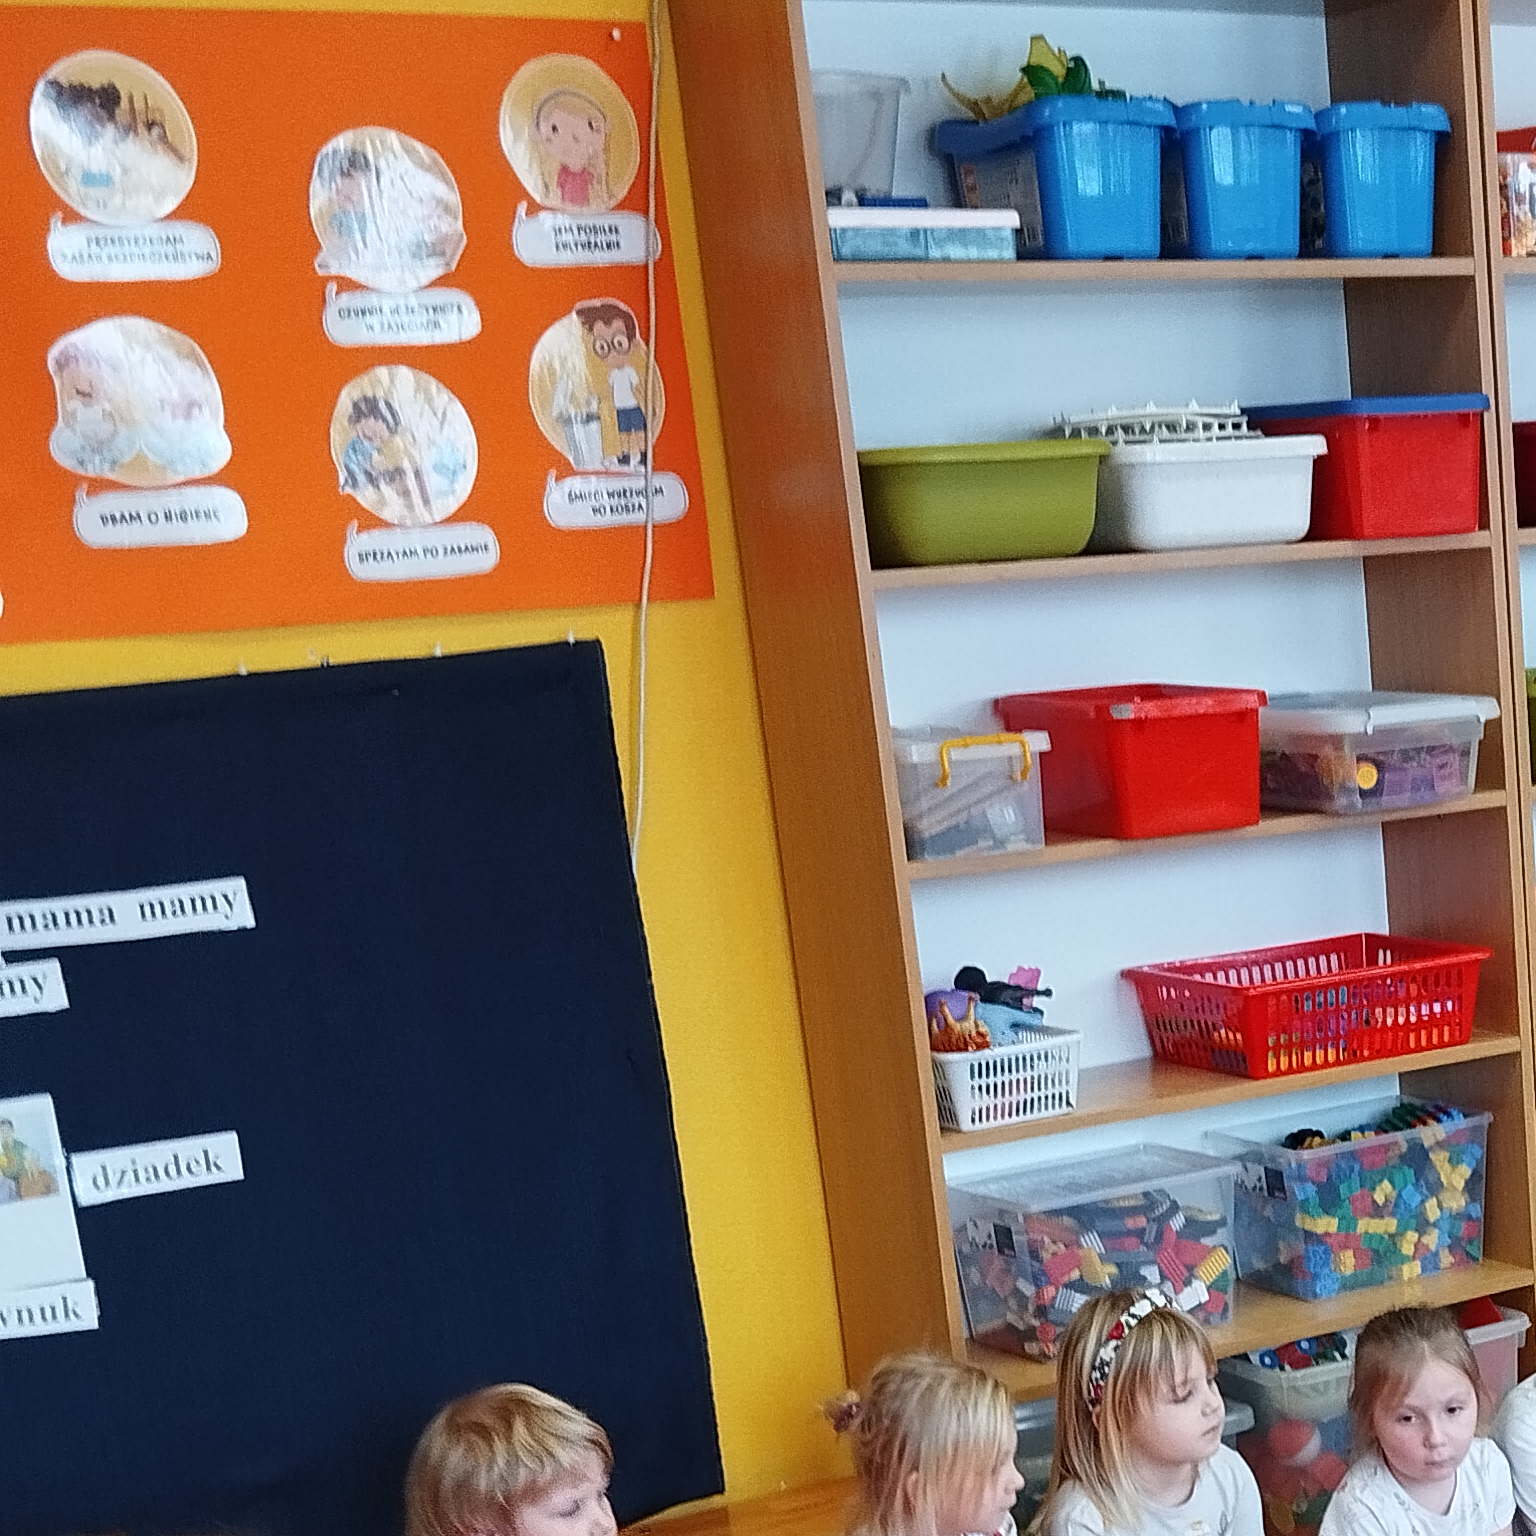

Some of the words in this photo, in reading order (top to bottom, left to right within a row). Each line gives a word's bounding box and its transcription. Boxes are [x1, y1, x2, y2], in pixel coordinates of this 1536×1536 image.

[4, 904, 117, 935] mama
[137, 889, 238, 922] mamy
[91, 1147, 226, 1192] dziadek
